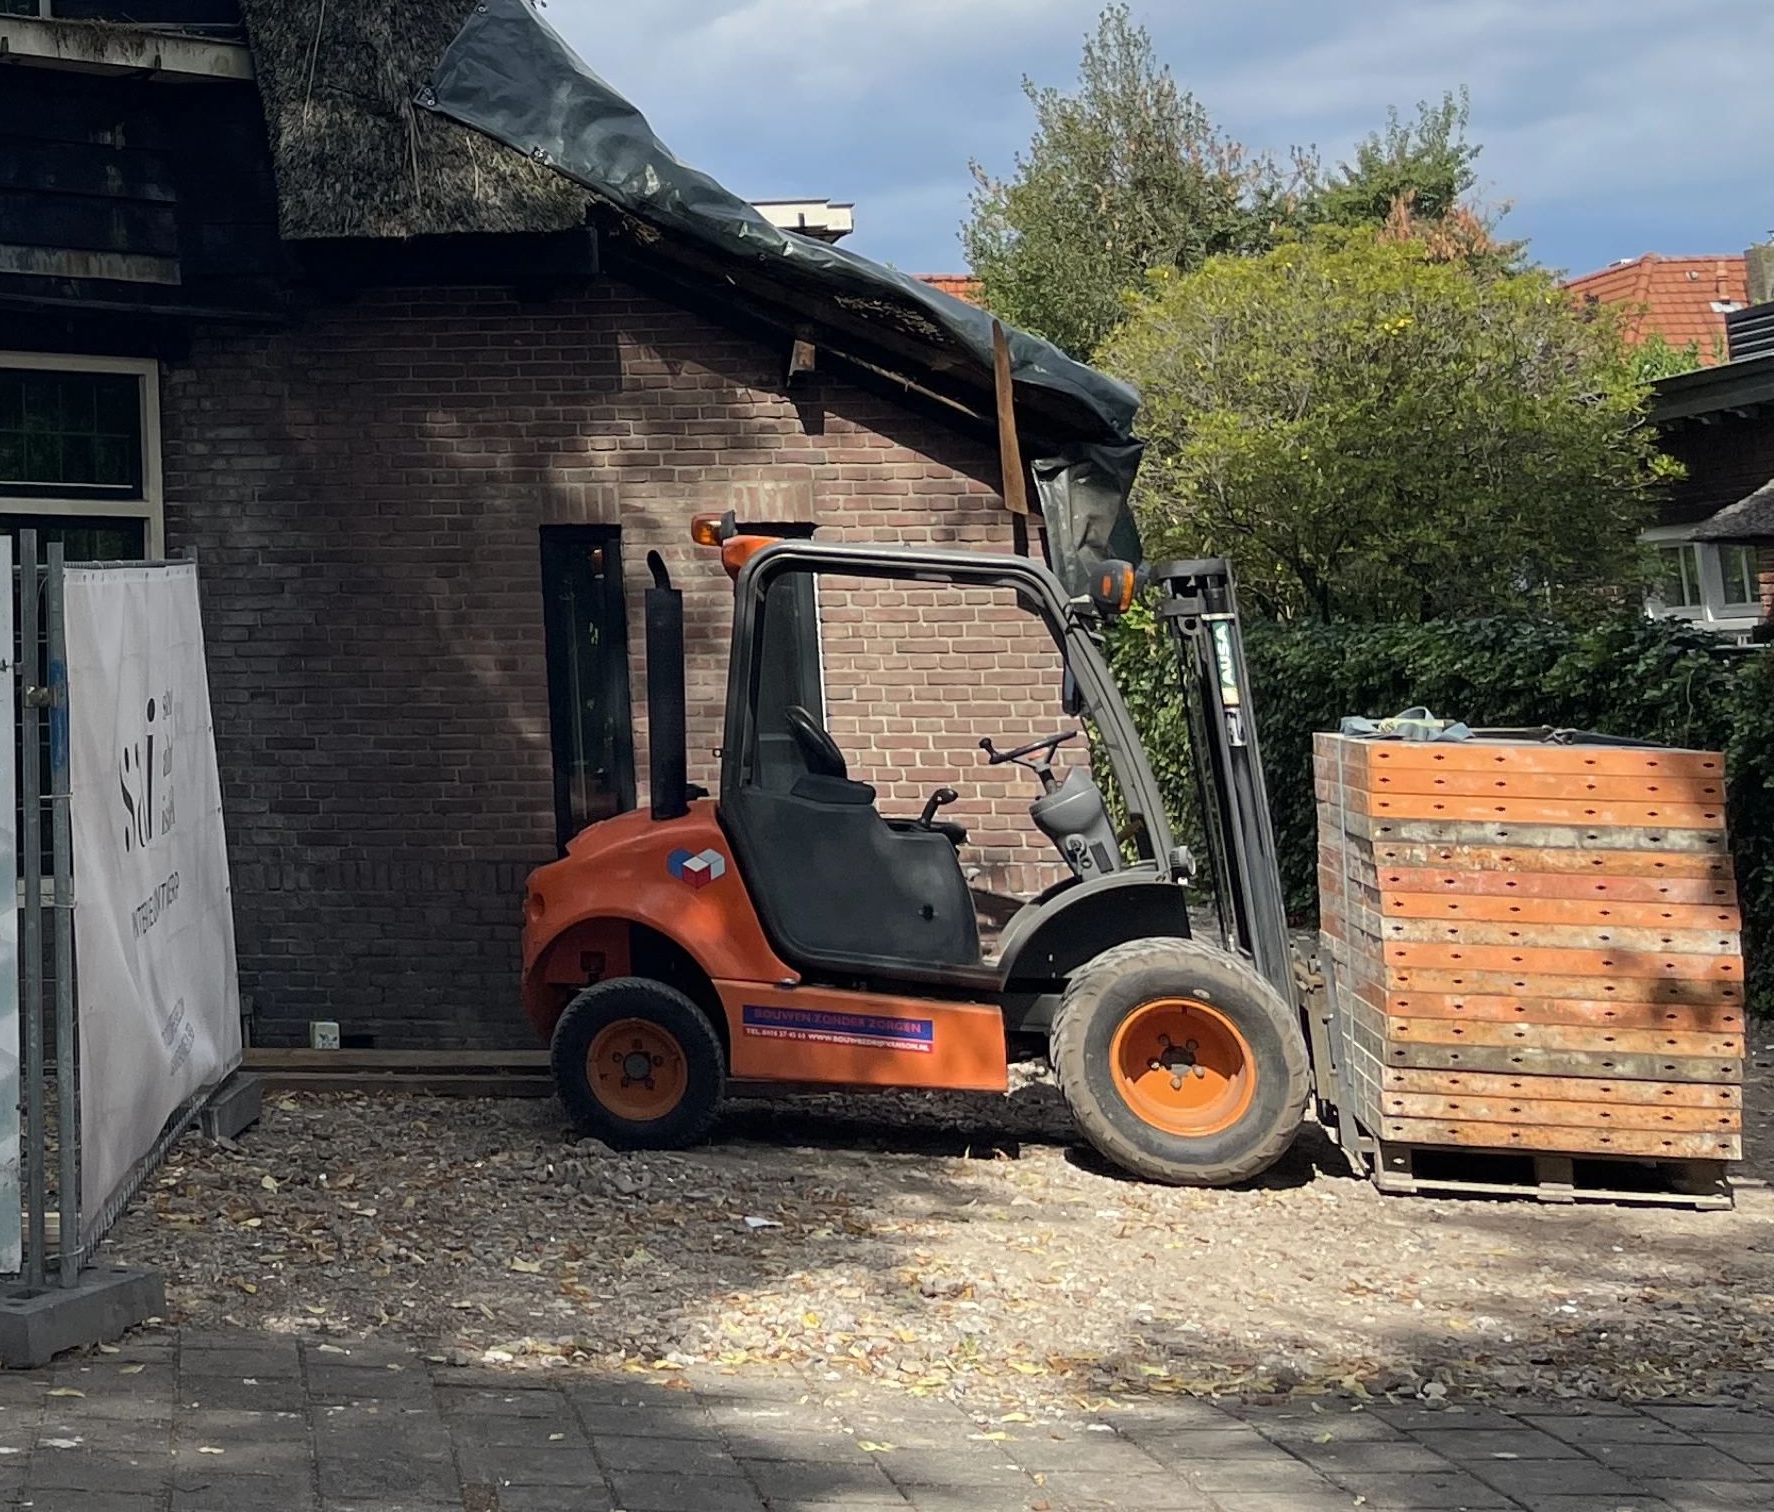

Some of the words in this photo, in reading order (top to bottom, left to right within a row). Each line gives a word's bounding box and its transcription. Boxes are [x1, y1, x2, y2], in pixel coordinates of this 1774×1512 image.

[1215, 624, 1235, 686] AUSA
[754, 1008, 811, 1022] BOUWEN
[869, 1019, 921, 1033] ZORGEN
